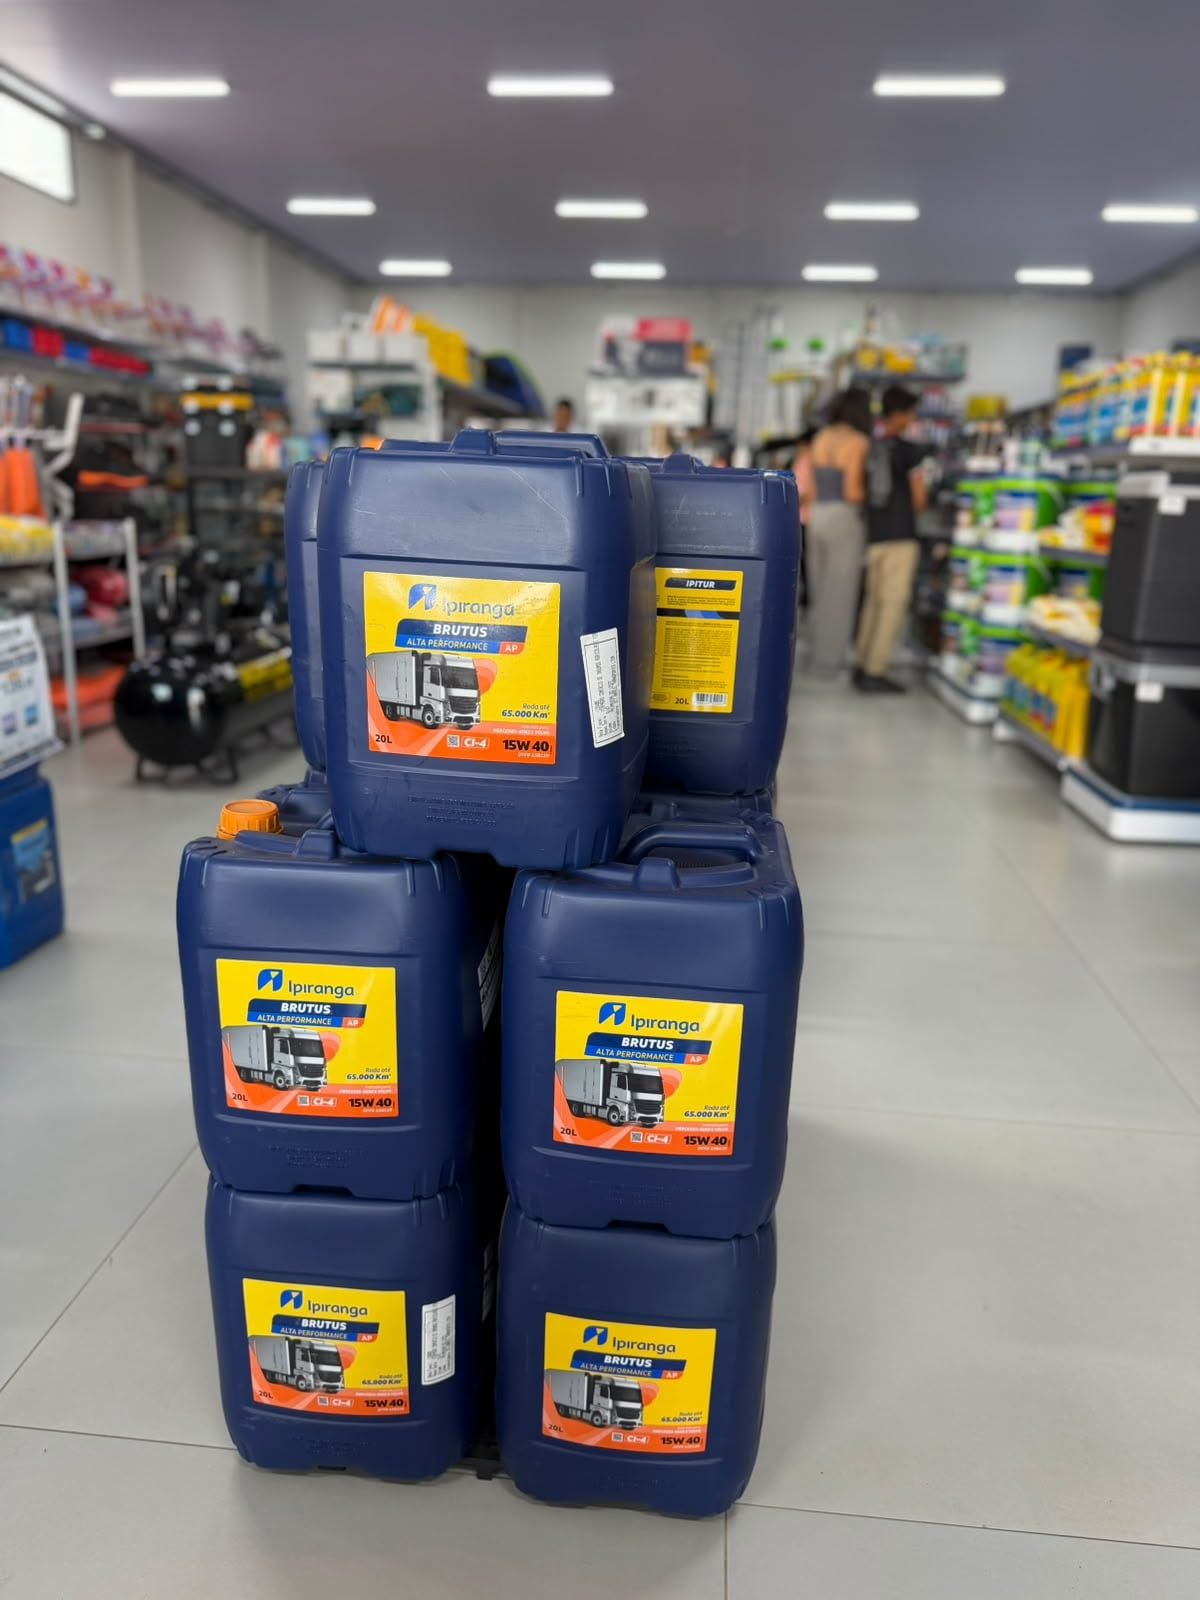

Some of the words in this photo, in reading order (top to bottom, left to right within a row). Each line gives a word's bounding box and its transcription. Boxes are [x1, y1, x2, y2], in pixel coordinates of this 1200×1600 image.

[686, 580, 715, 588] IPITUR
[443, 598, 515, 619] Ipiranga
[433, 624, 488, 637] BRUTUS
[406, 638, 425, 646] ALTA
[428, 639, 488, 651] PERFORMANCE
[505, 644, 518, 652] AP
[675, 697, 689, 705] 20L
[501, 709, 532, 718] 65.000
[375, 734, 393, 744] 20L
[502, 739, 530, 751] 15W
[531, 740, 550, 752] 40
[288, 980, 354, 999] Ipiranga
[281, 1002, 331, 1014] BRUTUS
[257, 1014, 275, 1022] ALTA
[276, 1015, 332, 1025] PERFORMANCE
[347, 1019, 359, 1027] AP
[631, 1014, 700, 1035] Ipiranga
[621, 1037, 674, 1050] BRUTUS
[596, 1048, 615, 1056] ALTA
[616, 1049, 674, 1061] PERFORMANCE
[689, 1055, 703, 1063] AP
[232, 1092, 249, 1102] 20L
[348, 1098, 375, 1107] 15W
[376, 1098, 392, 1107] 40
[684, 1110, 713, 1118] 65.000
[560, 1126, 577, 1136] 20L
[684, 1135, 711, 1145] 15W
[711, 1136, 728, 1146] 40
[308, 1299, 368, 1317] Ipiranga
[301, 1318, 347, 1330] BRUTUS
[280, 1327, 296, 1335] ALTA
[297, 1329, 348, 1340] PERFORMANCE
[613, 1337, 676, 1355] Ipiranga
[604, 1355, 652, 1368] BRUTUS
[580, 1362, 598, 1371] ALTA
[599, 1365, 652, 1377] PERFORMANCE
[666, 1371, 678, 1379] AP
[364, 1399, 387, 1408] 15W
[389, 1398, 404, 1407] 40
[661, 1436, 685, 1445] 15W
[686, 1436, 701, 1444] 40
